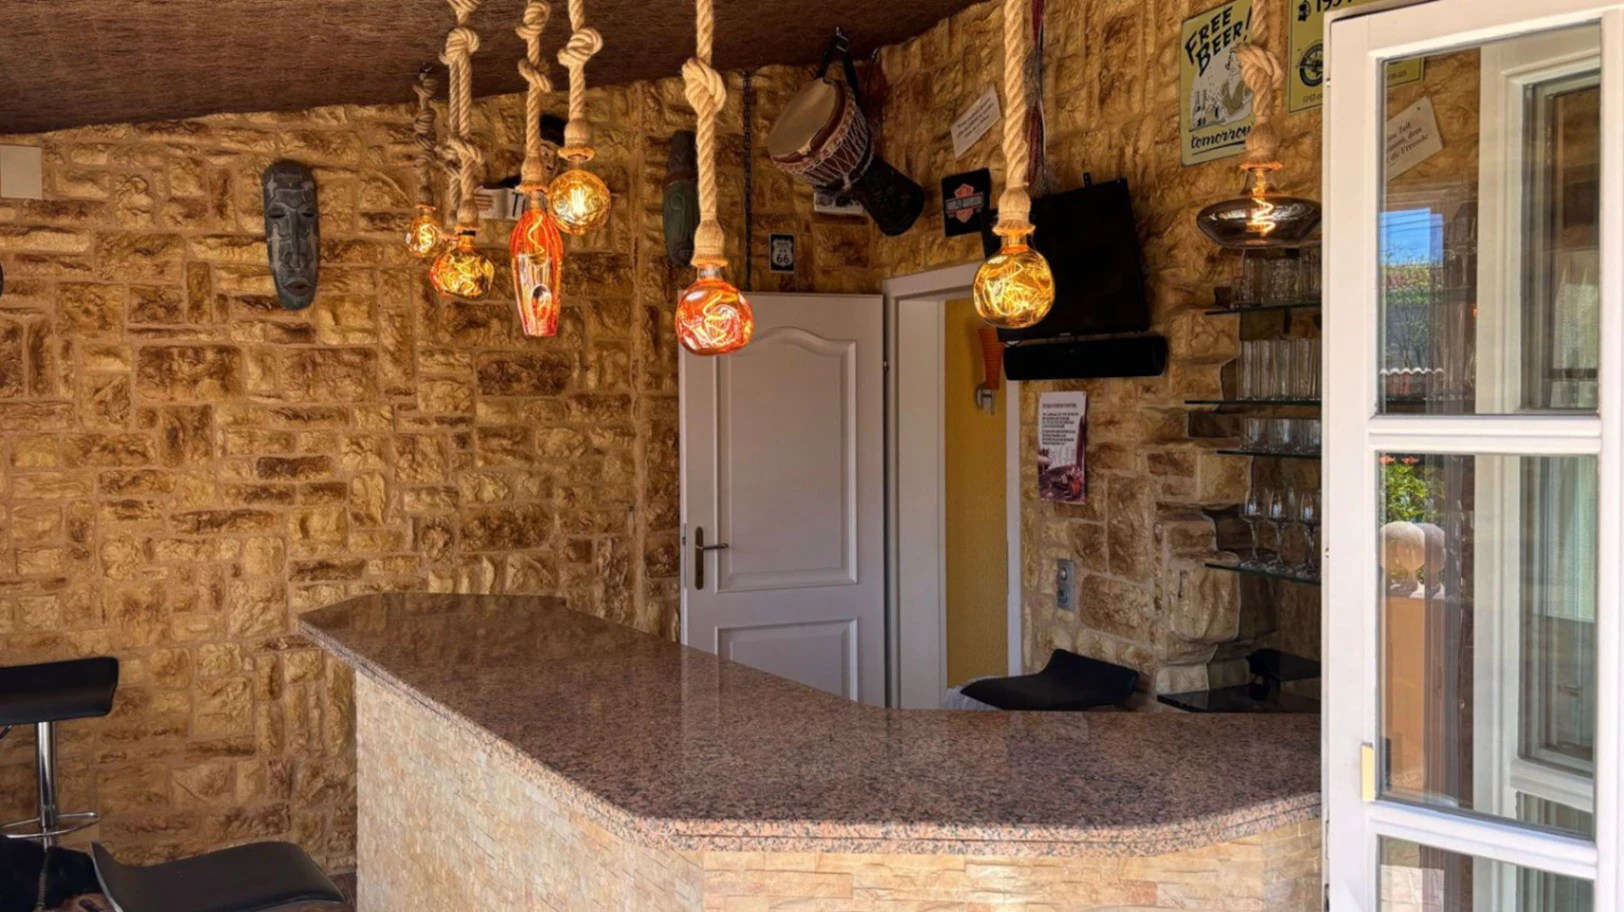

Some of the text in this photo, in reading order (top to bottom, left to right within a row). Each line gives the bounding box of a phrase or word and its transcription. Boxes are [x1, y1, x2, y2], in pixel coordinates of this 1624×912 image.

[1184, 6, 1233, 66] FREE
[1196, 6, 1252, 78] BEER!
[776, 253, 790, 265] 66
